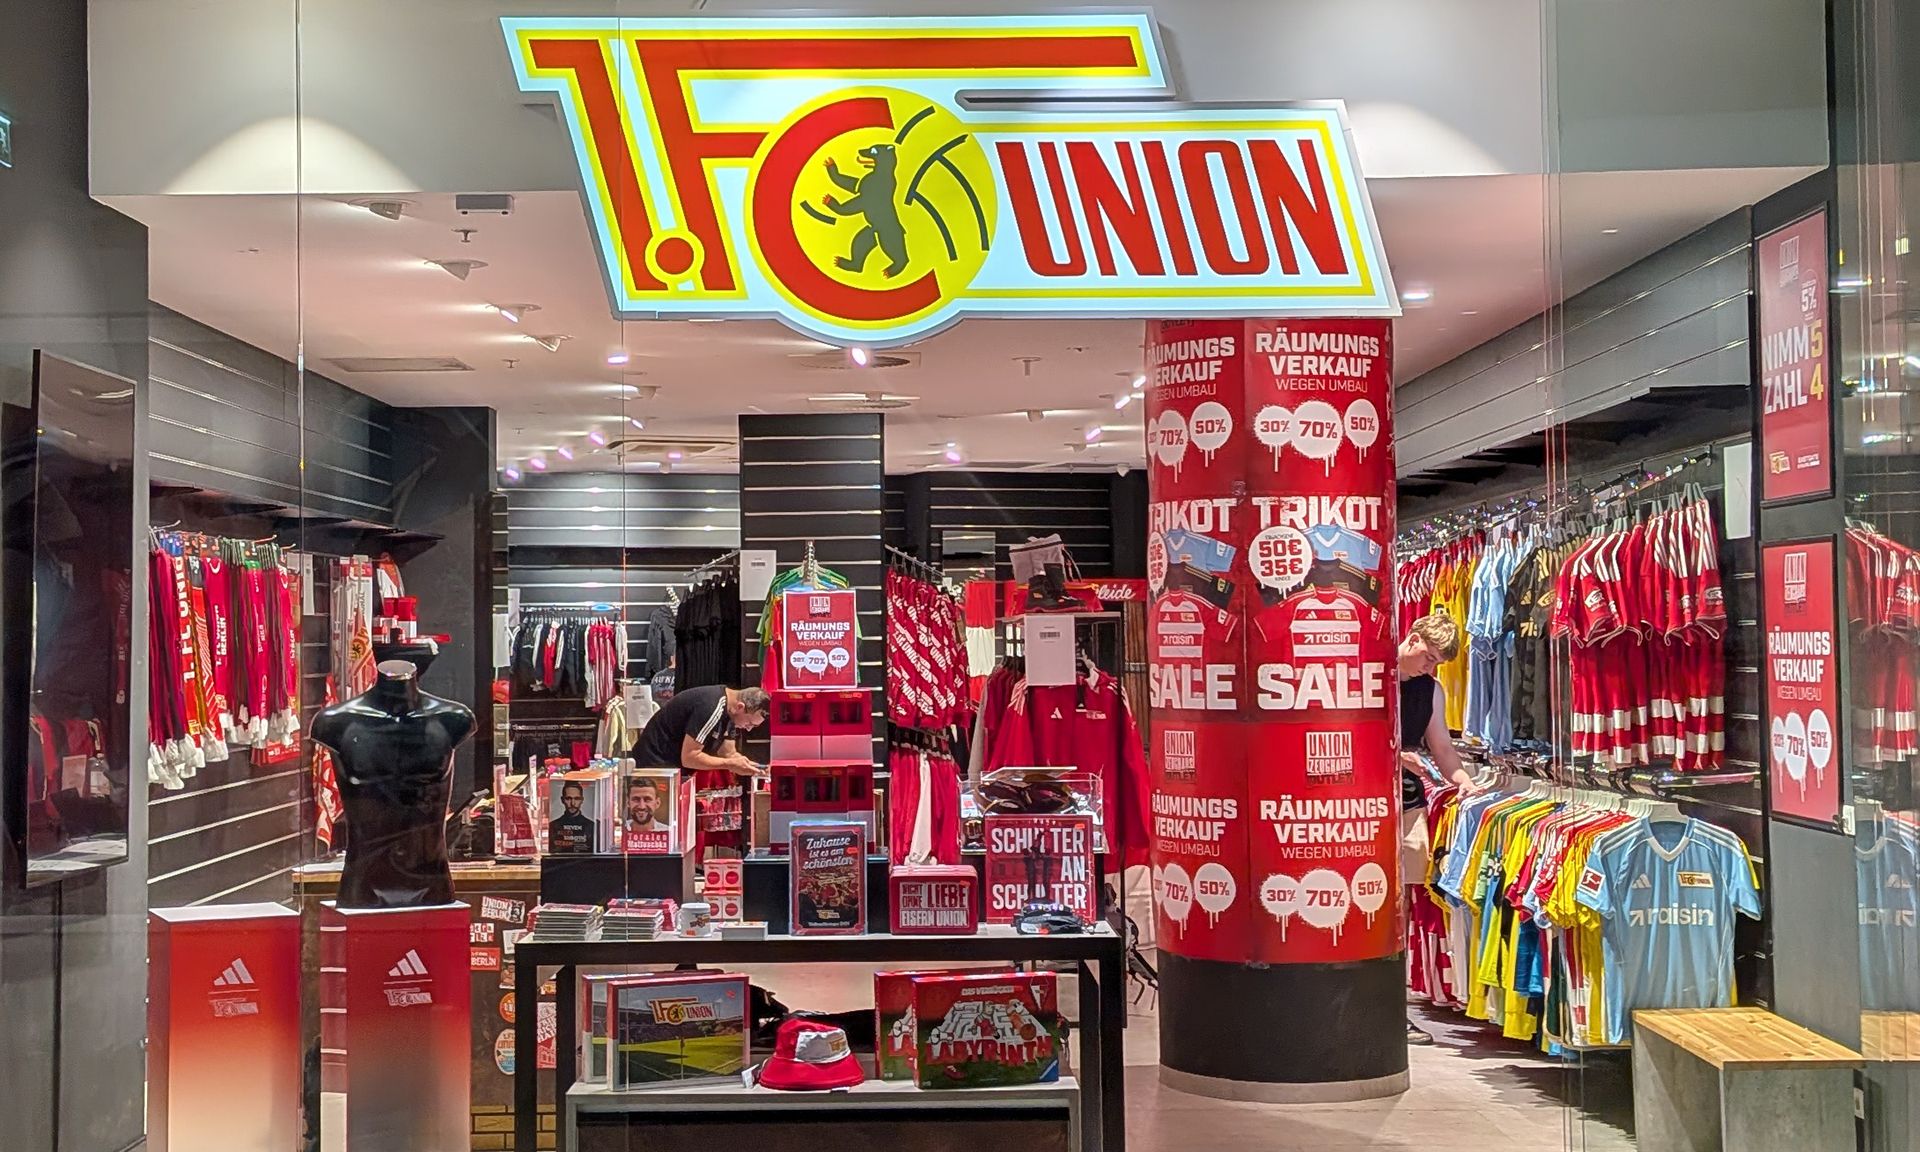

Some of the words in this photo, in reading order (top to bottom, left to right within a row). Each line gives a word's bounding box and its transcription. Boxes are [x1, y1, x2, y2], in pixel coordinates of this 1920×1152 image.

[995, 139, 1351, 277] UNION
[1255, 327, 1380, 357] RÄUMUNGS
[1763, 324, 1809, 372] NIMM
[1810, 319, 1823, 358] 5
[1268, 355, 1372, 379] VERKAUF
[1177, 384, 1217, 397] UMBAU
[1276, 378, 1326, 392] WEGEN
[1329, 379, 1368, 393] UMBAU
[1764, 369, 1808, 415] ZAHL
[1810, 363, 1824, 401] 4
[1195, 418, 1227, 434] 50%
[1299, 420, 1338, 439] 70%
[1350, 416, 1376, 432] 50%
[1160, 429, 1184, 446] 70%
[1252, 496, 1382, 532] TRIKOT
[1258, 539, 1302, 558] 50€
[1260, 558, 1304, 577] 35€
[791, 620, 850, 631] RÄUMUNGS
[796, 631, 845, 641] VERKAUF
[1316, 631, 1351, 644] raisin
[1768, 626, 1831, 656] RÄUMUNGS
[808, 657, 826, 665] 70%
[1773, 658, 1824, 683] VERKAUF
[1149, 663, 1237, 710] SALE
[1257, 662, 1385, 711] SALE
[1309, 732, 1351, 757] UNION
[1787, 734, 1805, 757] 70%
[1810, 730, 1829, 749] 50%
[1260, 794, 1389, 820] RÄUMUNGS
[1155, 816, 1226, 841] VERKAUF
[1273, 820, 1381, 844] VERKAUF
[1181, 843, 1220, 857] UMBAU
[1281, 846, 1332, 860] WEGEN
[1335, 844, 1376, 859] UMBAU
[1061, 855, 1085, 882] AN
[927, 884, 967, 907] LIEBE
[1165, 881, 1189, 902] 70%
[1200, 880, 1230, 896] 50%
[1358, 879, 1384, 895] 50%
[482, 896, 509, 911] UNION
[1306, 889, 1346, 908] 70%
[901, 911, 934, 926] EISERN
[1648, 902, 1714, 926] raisin
[470, 956, 497, 967] BERLIN
[925, 1035, 1054, 1066] LABYRINTH
